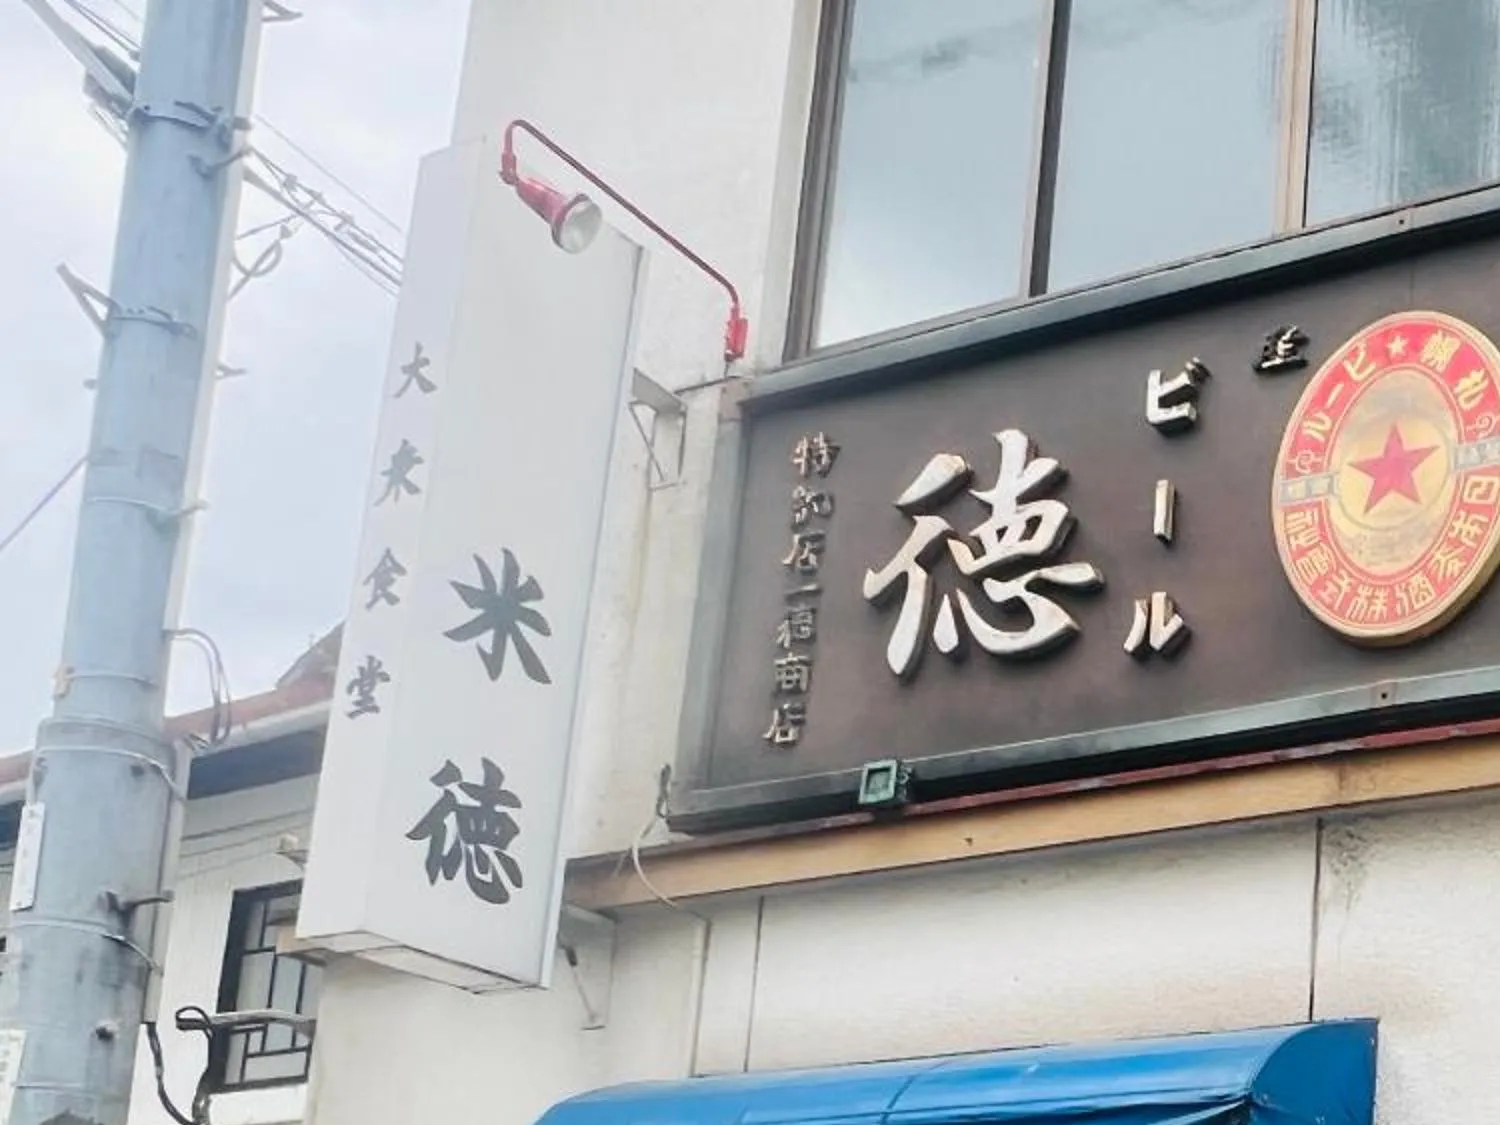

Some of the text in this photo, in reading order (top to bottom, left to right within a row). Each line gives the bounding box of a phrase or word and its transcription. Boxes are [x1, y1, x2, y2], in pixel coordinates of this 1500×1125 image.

[345, 342, 437, 720] 大衆食堂
[863, 428, 1107, 684] 徳
[1122, 359, 1209, 662] ビール
[405, 547, 552, 905] 米徳
